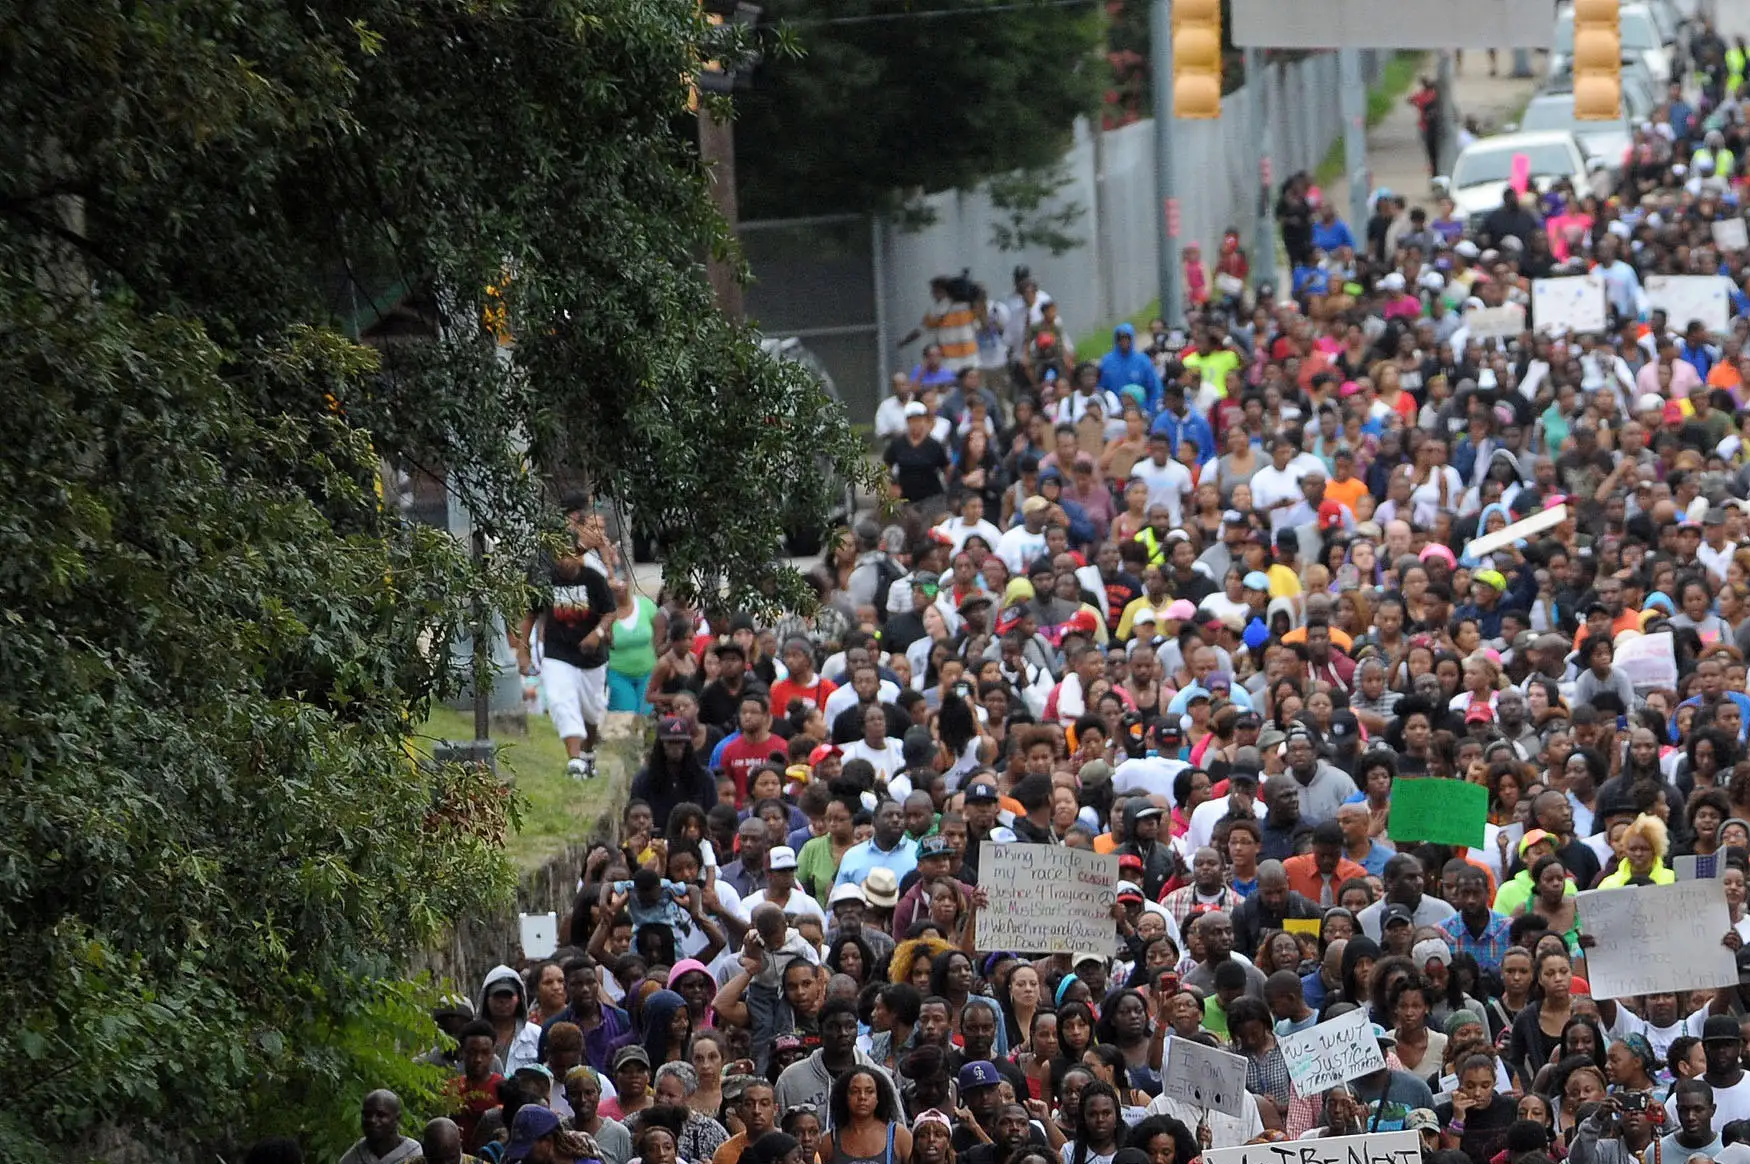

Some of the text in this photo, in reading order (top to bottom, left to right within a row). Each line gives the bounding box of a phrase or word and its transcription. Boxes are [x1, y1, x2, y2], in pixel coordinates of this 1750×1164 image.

[987, 844, 1107, 872] Taking Pride in
[994, 867, 1015, 886] my
[1036, 885, 1044, 899] 4
[1320, 1022, 1366, 1049] WANT
